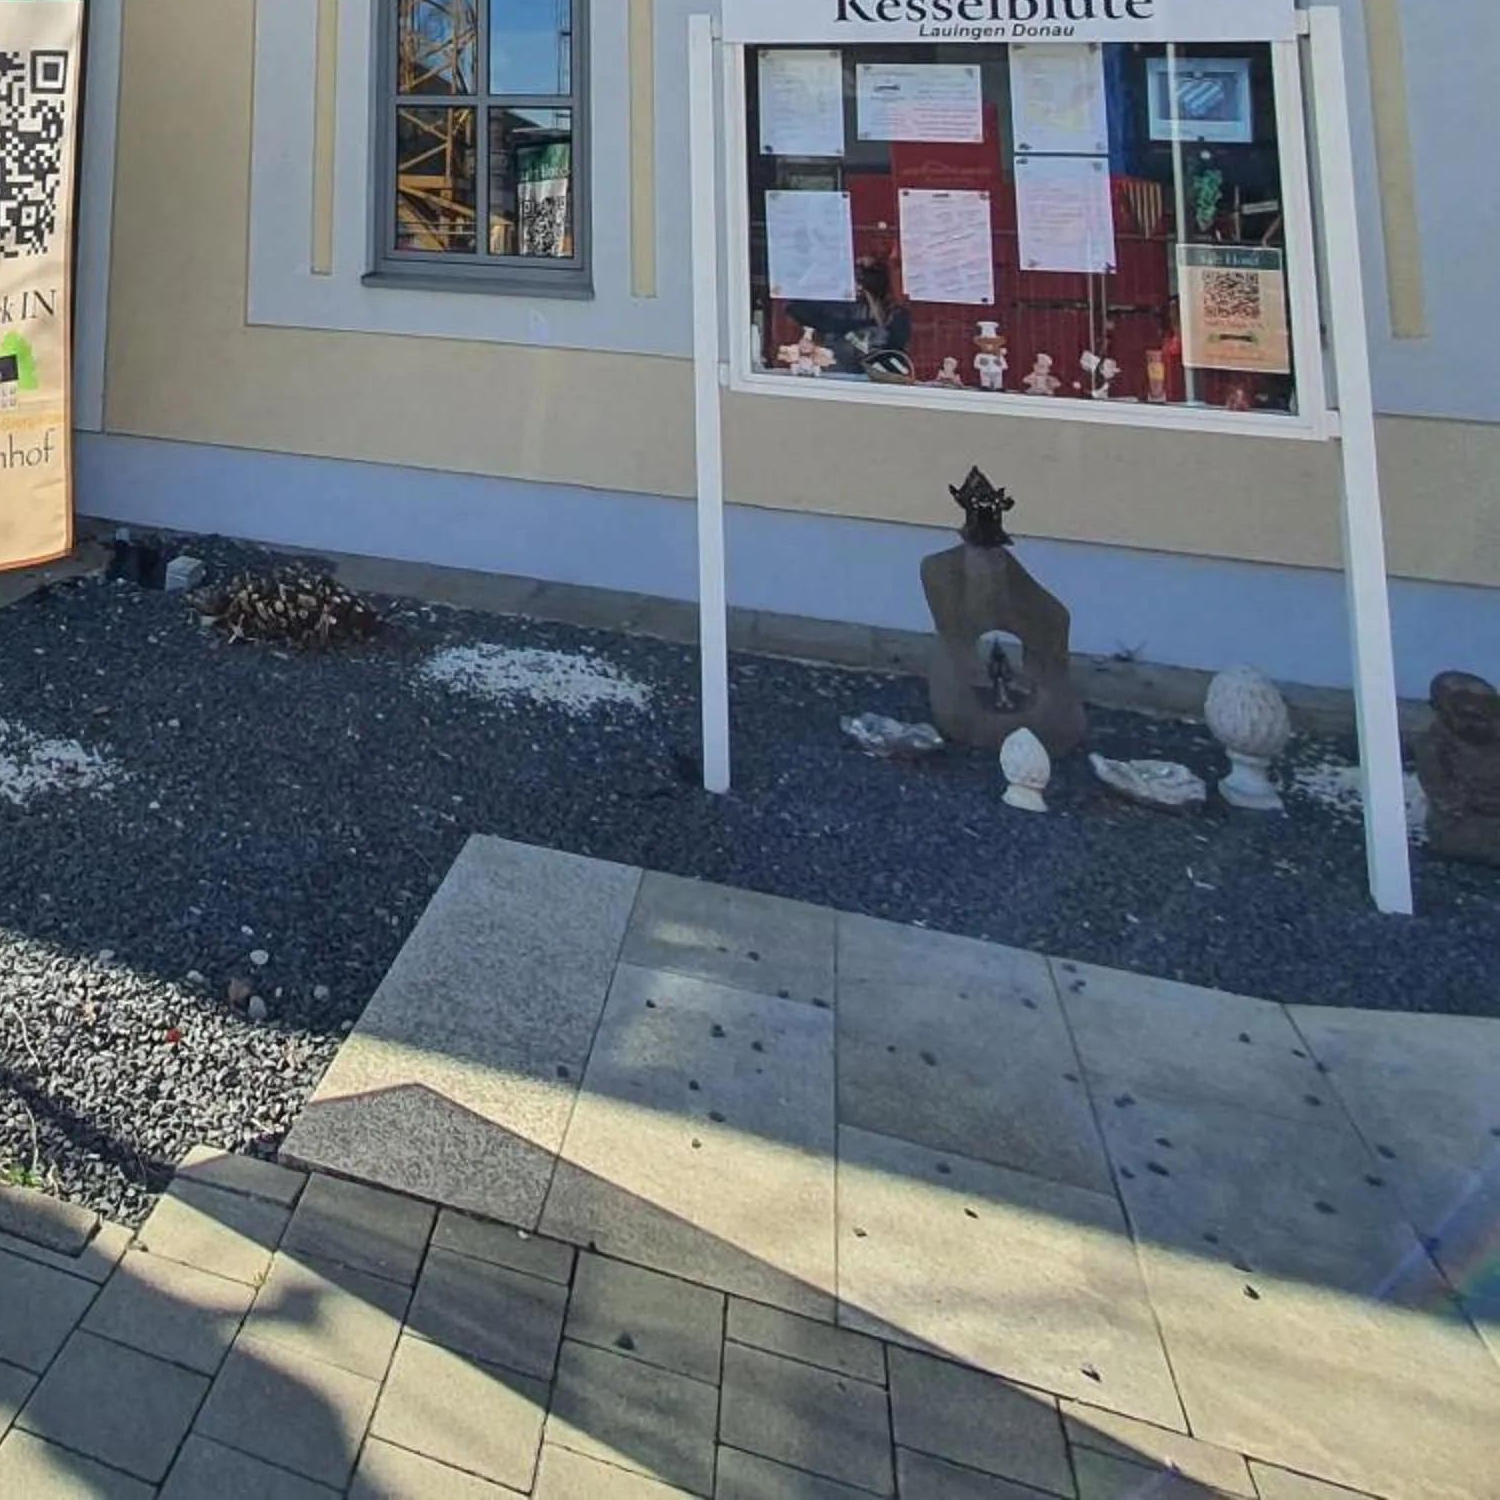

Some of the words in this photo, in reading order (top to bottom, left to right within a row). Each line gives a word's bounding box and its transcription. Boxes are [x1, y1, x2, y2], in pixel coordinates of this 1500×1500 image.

[918, 23, 1006, 41] Lauingen
[1011, 23, 1075, 38] Donau
[21, 289, 57, 321] IN
